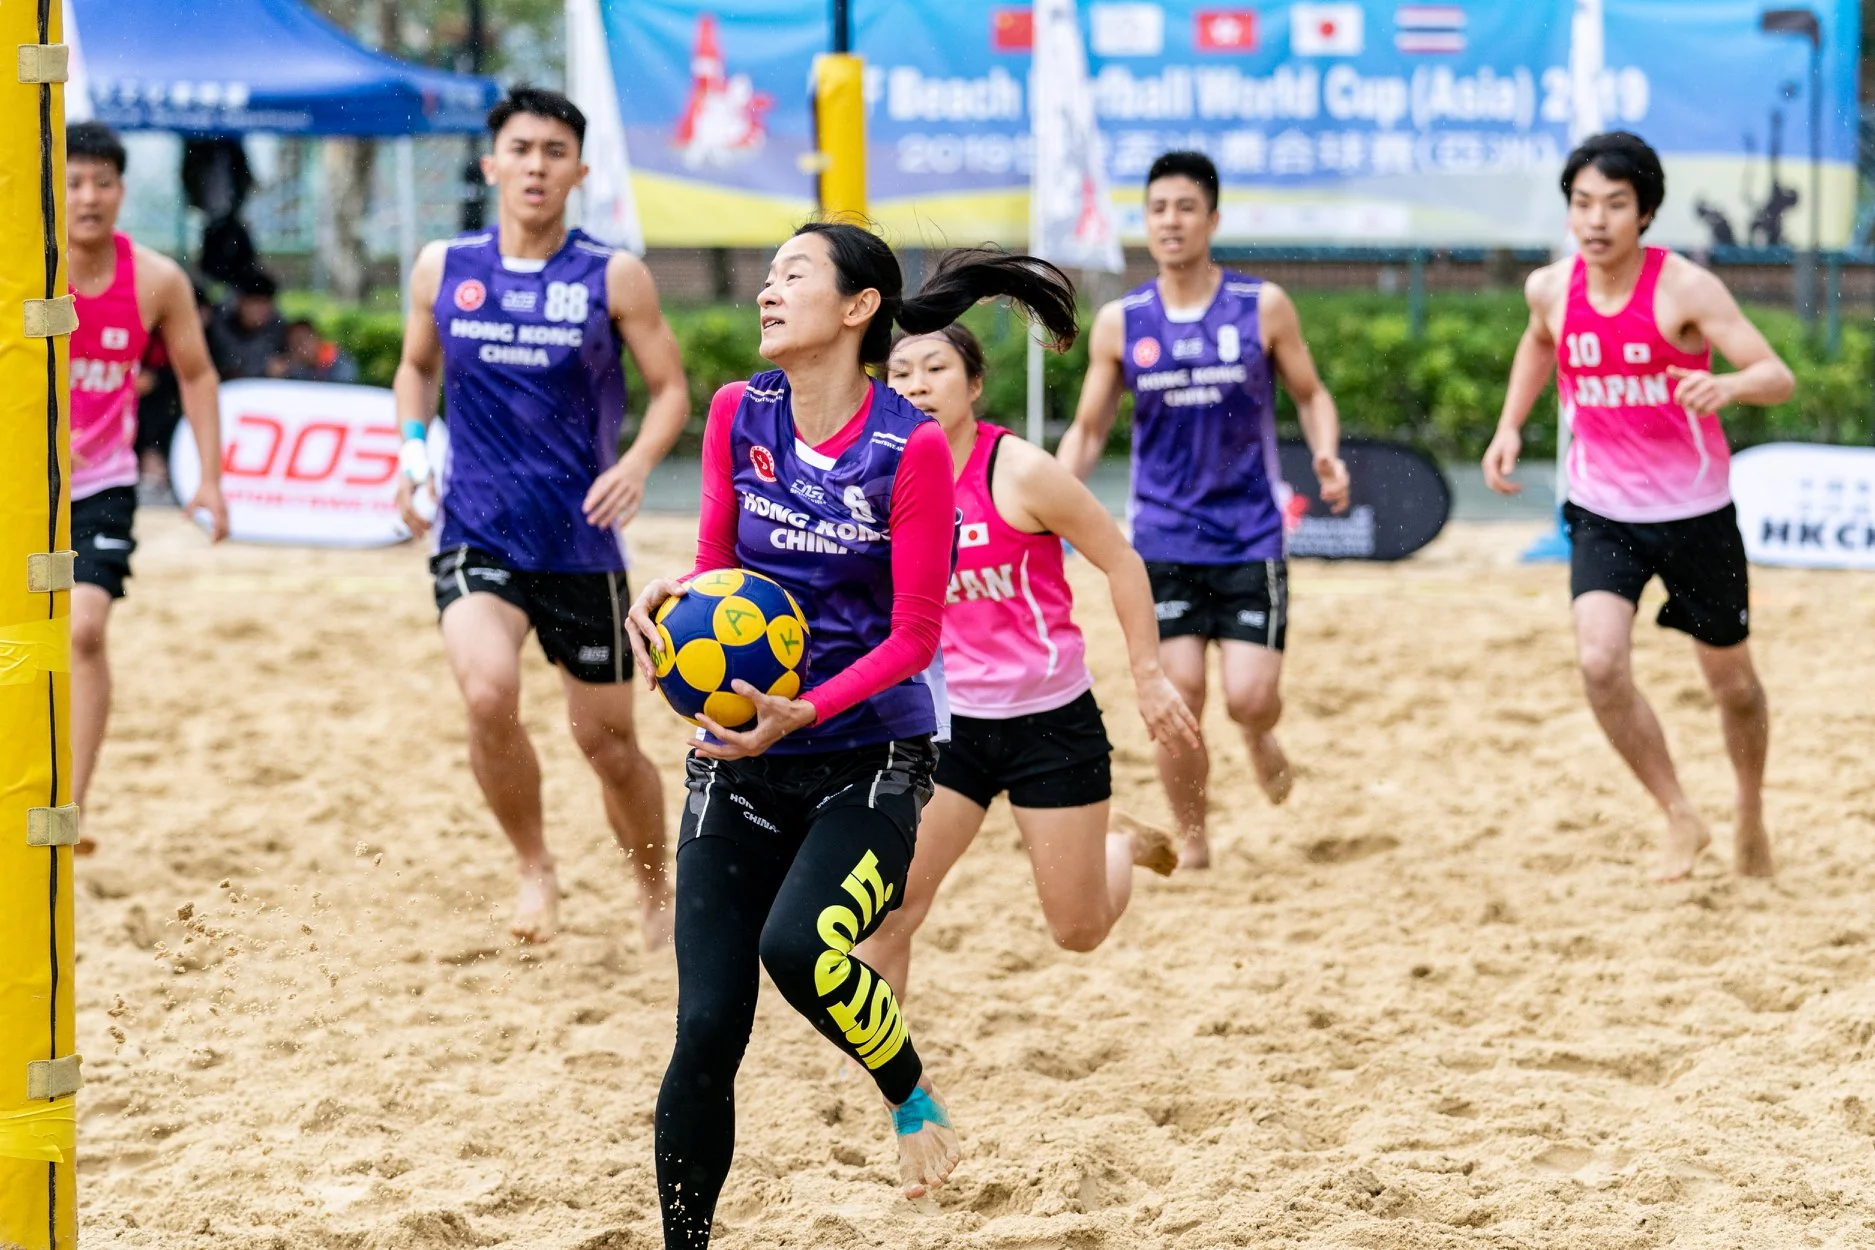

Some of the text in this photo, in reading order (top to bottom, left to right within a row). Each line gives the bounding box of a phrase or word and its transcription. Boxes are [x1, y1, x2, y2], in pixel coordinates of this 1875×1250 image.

[890, 66, 1021, 120] Beach
[1198, 65, 1318, 120] World
[1326, 64, 1406, 129] Cup
[1412, 65, 1534, 131] (Asia)
[1542, 67, 1648, 121] 219
[545, 281, 589, 323] 88
[451, 318, 583, 347] HONG KONG
[1566, 332, 1601, 368] 10
[479, 344, 550, 367] CHINA
[70, 357, 124, 392] PAN
[1575, 373, 1670, 408] JAPAN
[742, 491, 810, 528] HONG
[945, 563, 1016, 604] PAN
